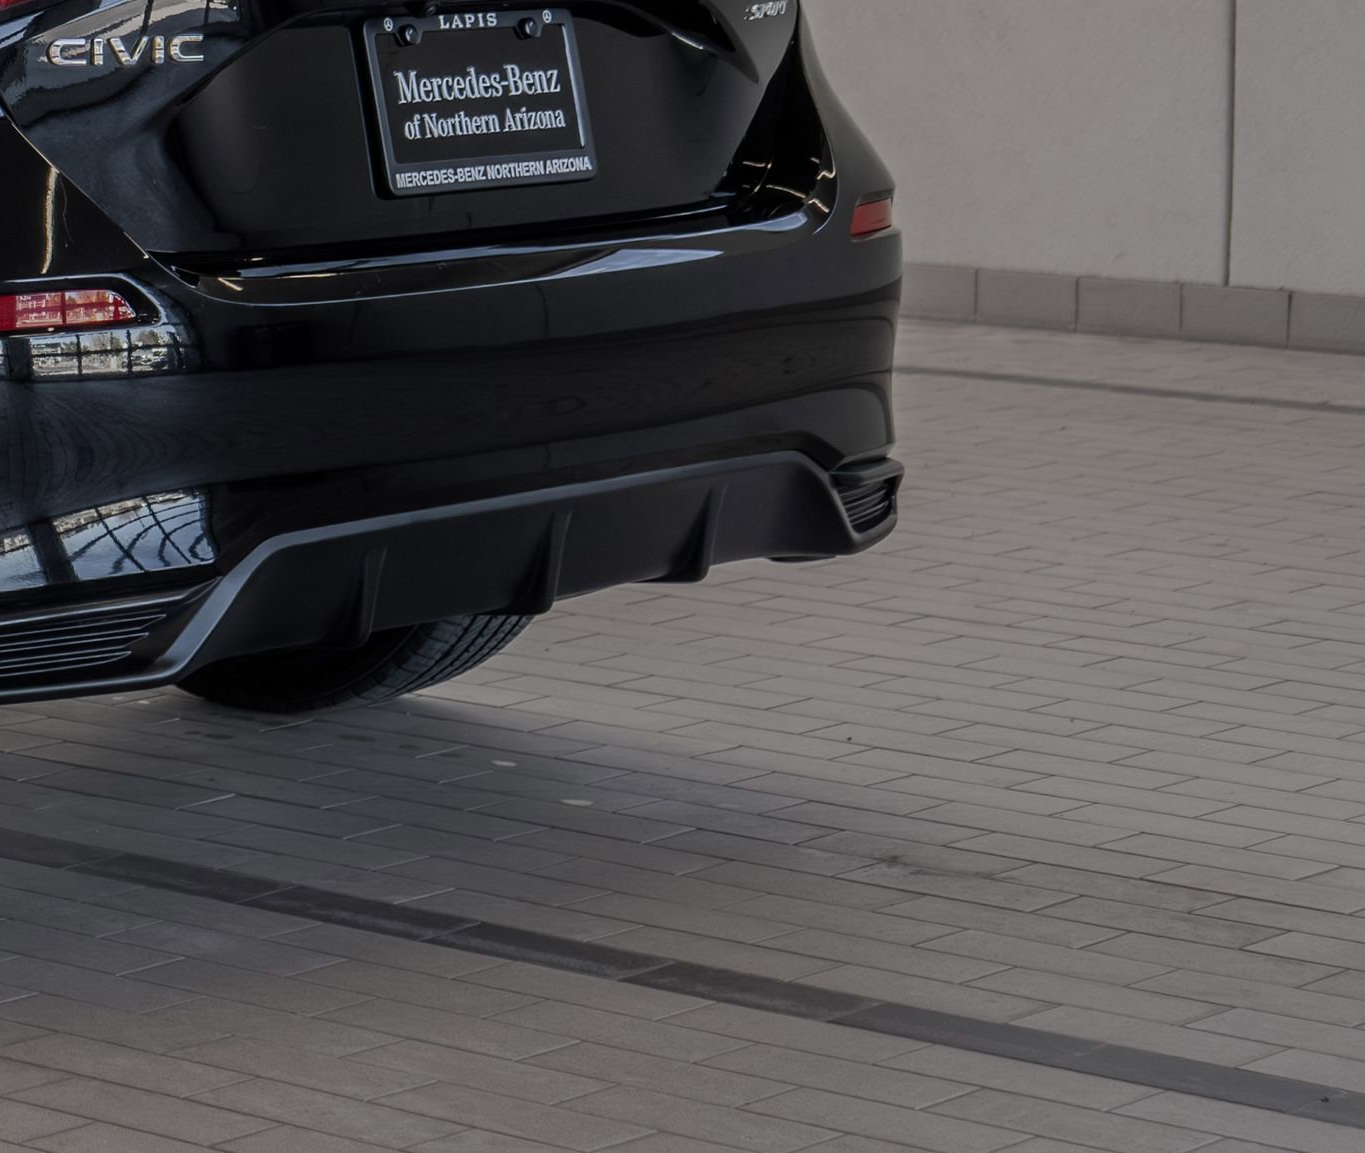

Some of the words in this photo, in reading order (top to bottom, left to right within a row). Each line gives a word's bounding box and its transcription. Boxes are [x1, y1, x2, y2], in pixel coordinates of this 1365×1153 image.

[438, 12, 498, 30] LAPIS
[48, 34, 204, 67] CIVIC
[393, 64, 561, 105] Mercedes-Benz
[404, 113, 421, 140] of
[423, 110, 500, 139] Northern
[503, 106, 566, 132] Arizona
[395, 165, 486, 189] MERCEDES-BENZ
[486, 160, 544, 181] NORTHERN
[546, 155, 593, 175] ARIZONA
